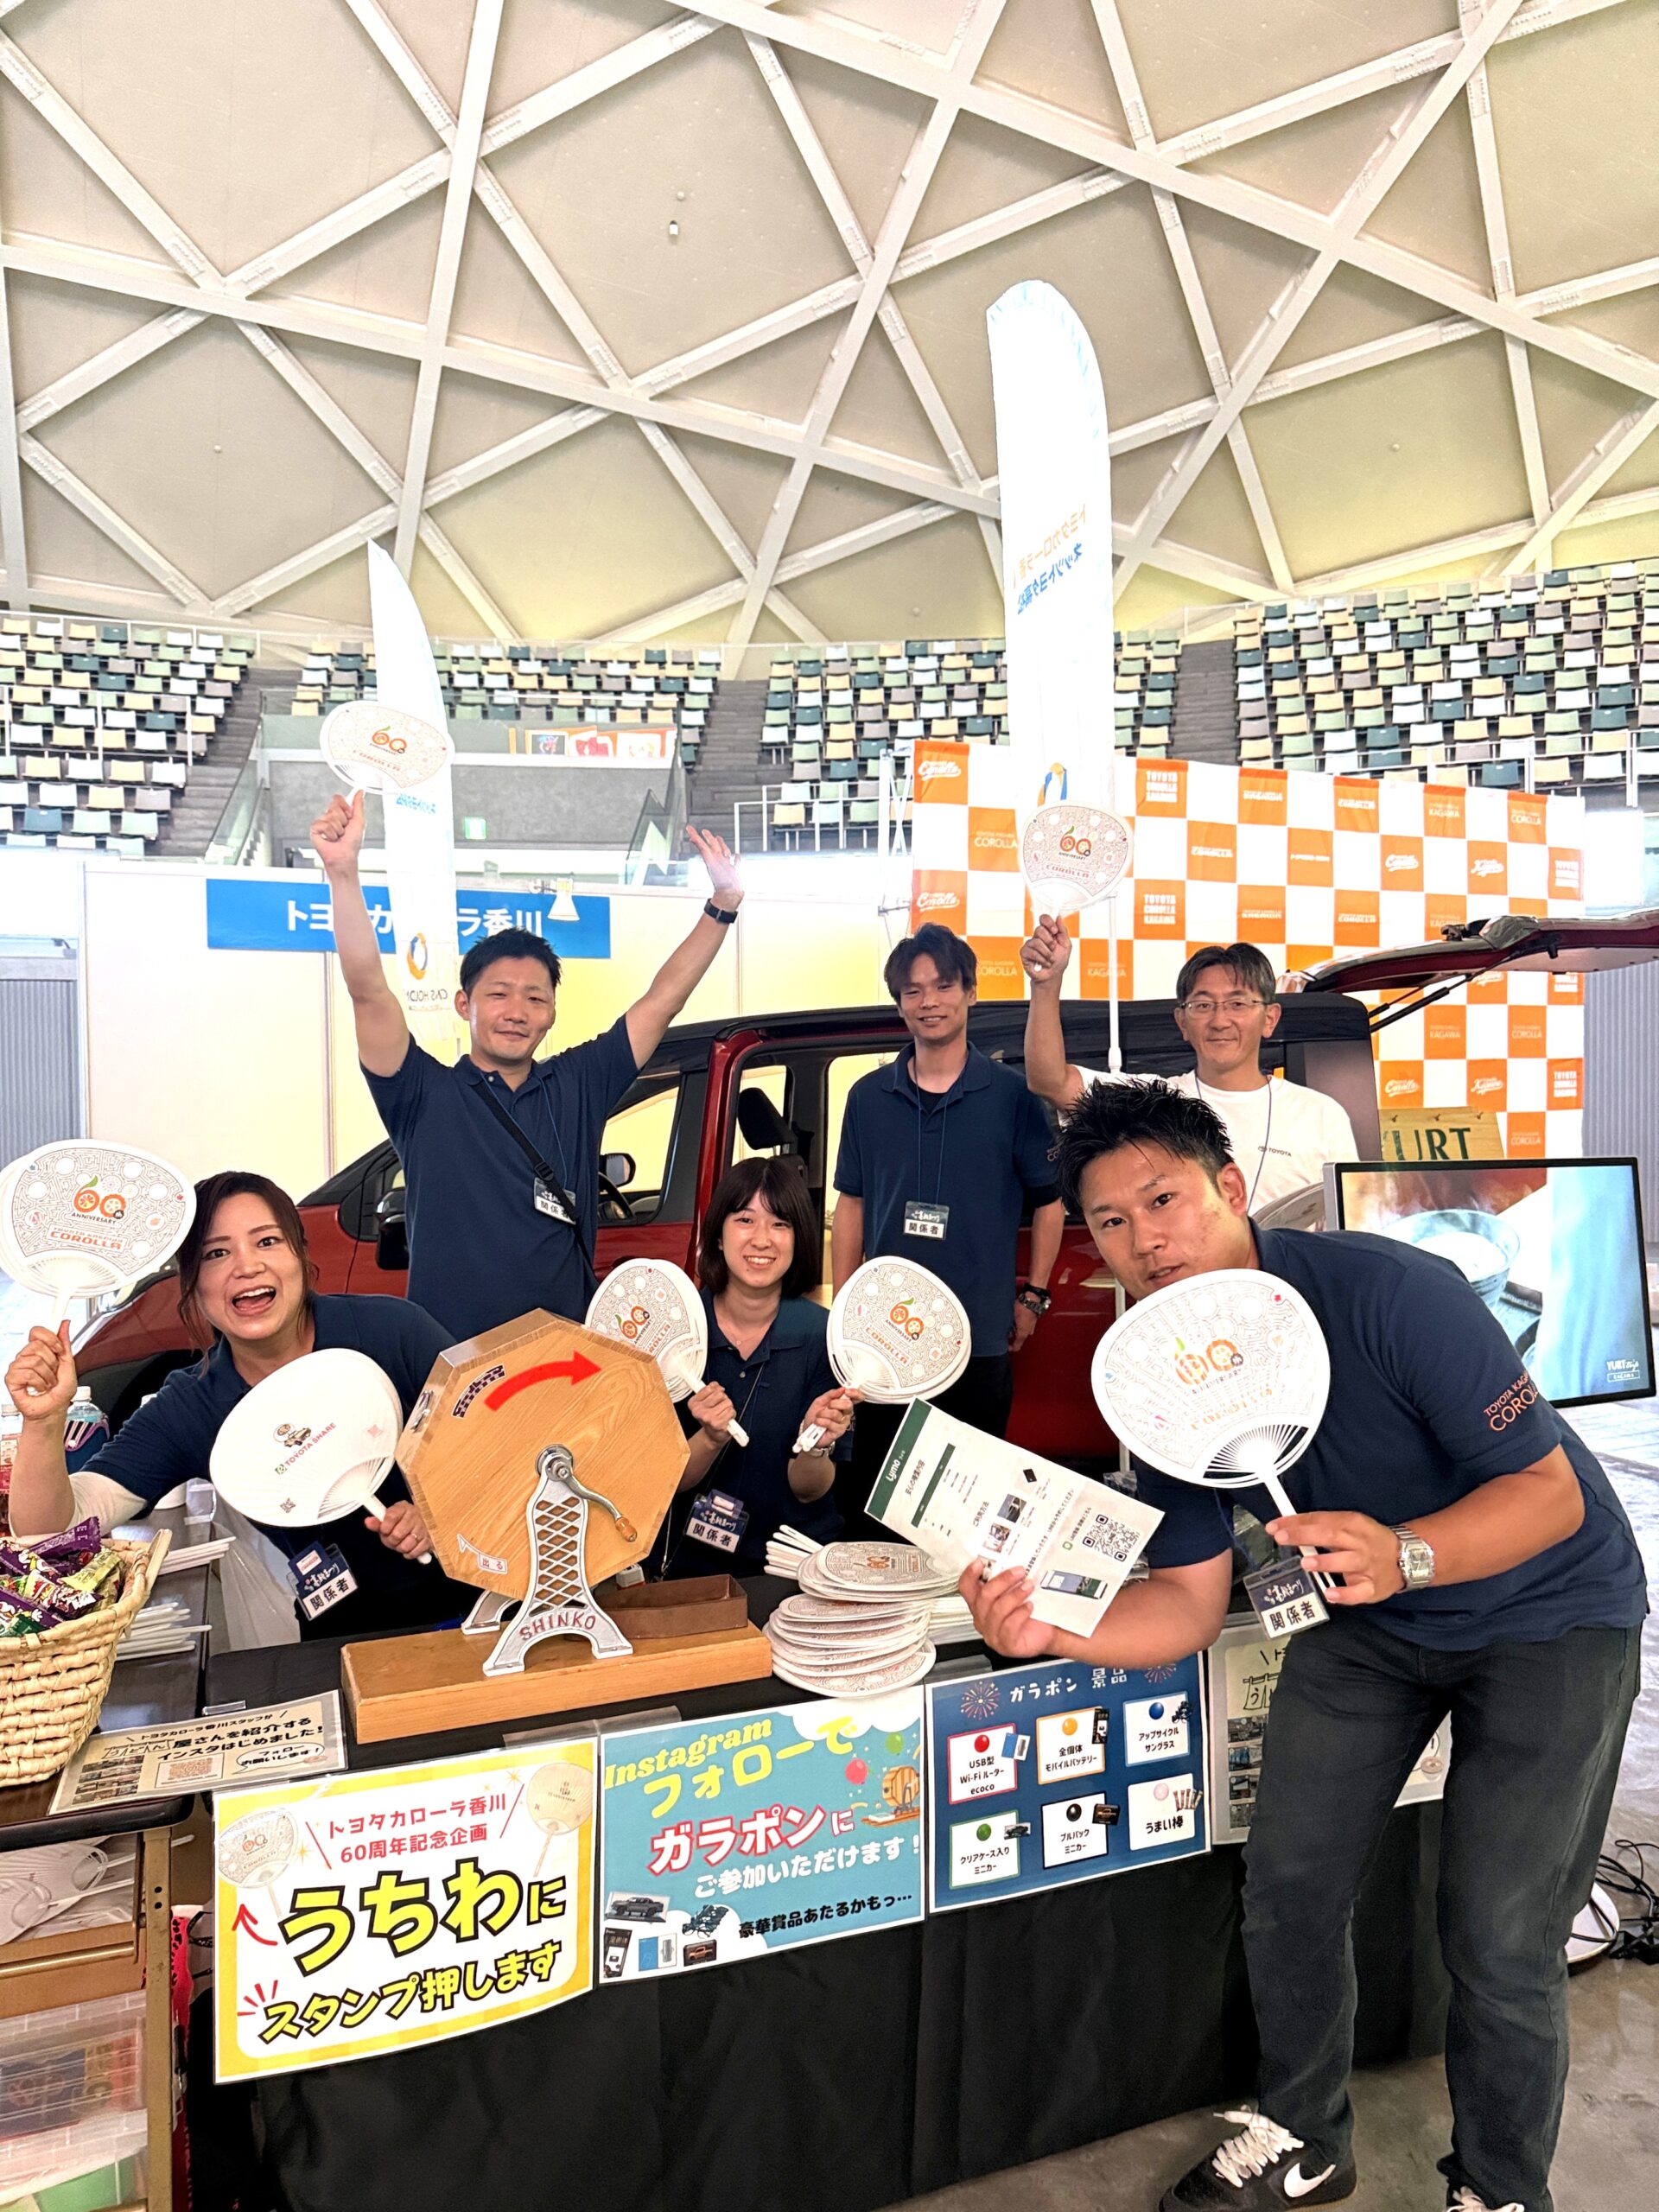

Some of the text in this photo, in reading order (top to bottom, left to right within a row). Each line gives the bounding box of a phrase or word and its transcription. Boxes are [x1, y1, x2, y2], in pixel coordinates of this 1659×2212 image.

[1268, 1147, 1292, 1157] TOYOTA
[72, 1212, 117, 1225] ANNIVERSARY
[909, 1223, 938, 1235] 関係者
[50, 1231, 122, 1250] COROLLA
[649, 1323, 671, 1354] ROLLA
[866, 1327, 909, 1365] COROLLA
[1484, 1389, 1515, 1418] TOYOTA
[284, 1422, 337, 1466] TOYOTA SHARE
[693, 1523, 732, 1547] 関係者
[482, 1558, 505, 1572] 出る
[310, 1578, 349, 1611] 関係者
[518, 1612, 596, 1642] SHINKO
[1269, 1601, 1315, 1631] 関係者
[1010, 1668, 1128, 1702] ガラポン 景品
[141, 1713, 273, 1740] トヨタカローラ香川スタッフが
[1139, 1728, 1179, 1741] アップサイクル
[258, 1745, 305, 1756] フォロー
[604, 1718, 772, 1790] Instagram
[1058, 1745, 1083, 1758] 全個体
[1145, 1741, 1175, 1752] サングラス
[644, 1715, 857, 1819] フォローで
[969, 1756, 995, 1769] USB型
[1046, 1755, 1097, 1772] モバイルバッテリー
[970, 1783, 995, 1795] ecoco
[329, 1793, 506, 1840] トヨタカローラ香川
[1145, 1816, 1184, 1834] うまい棒
[340, 1823, 488, 1864] 60周年記念企画
[647, 1804, 855, 1877] ガラポンに
[1065, 1844, 1087, 1854] ミニカー
[960, 1847, 1010, 1865] クリアケース入り
[974, 1864, 997, 1875] ミニカー
[278, 1857, 566, 1977] うちわに
[259, 1939, 562, 2044] スタンプ押します
